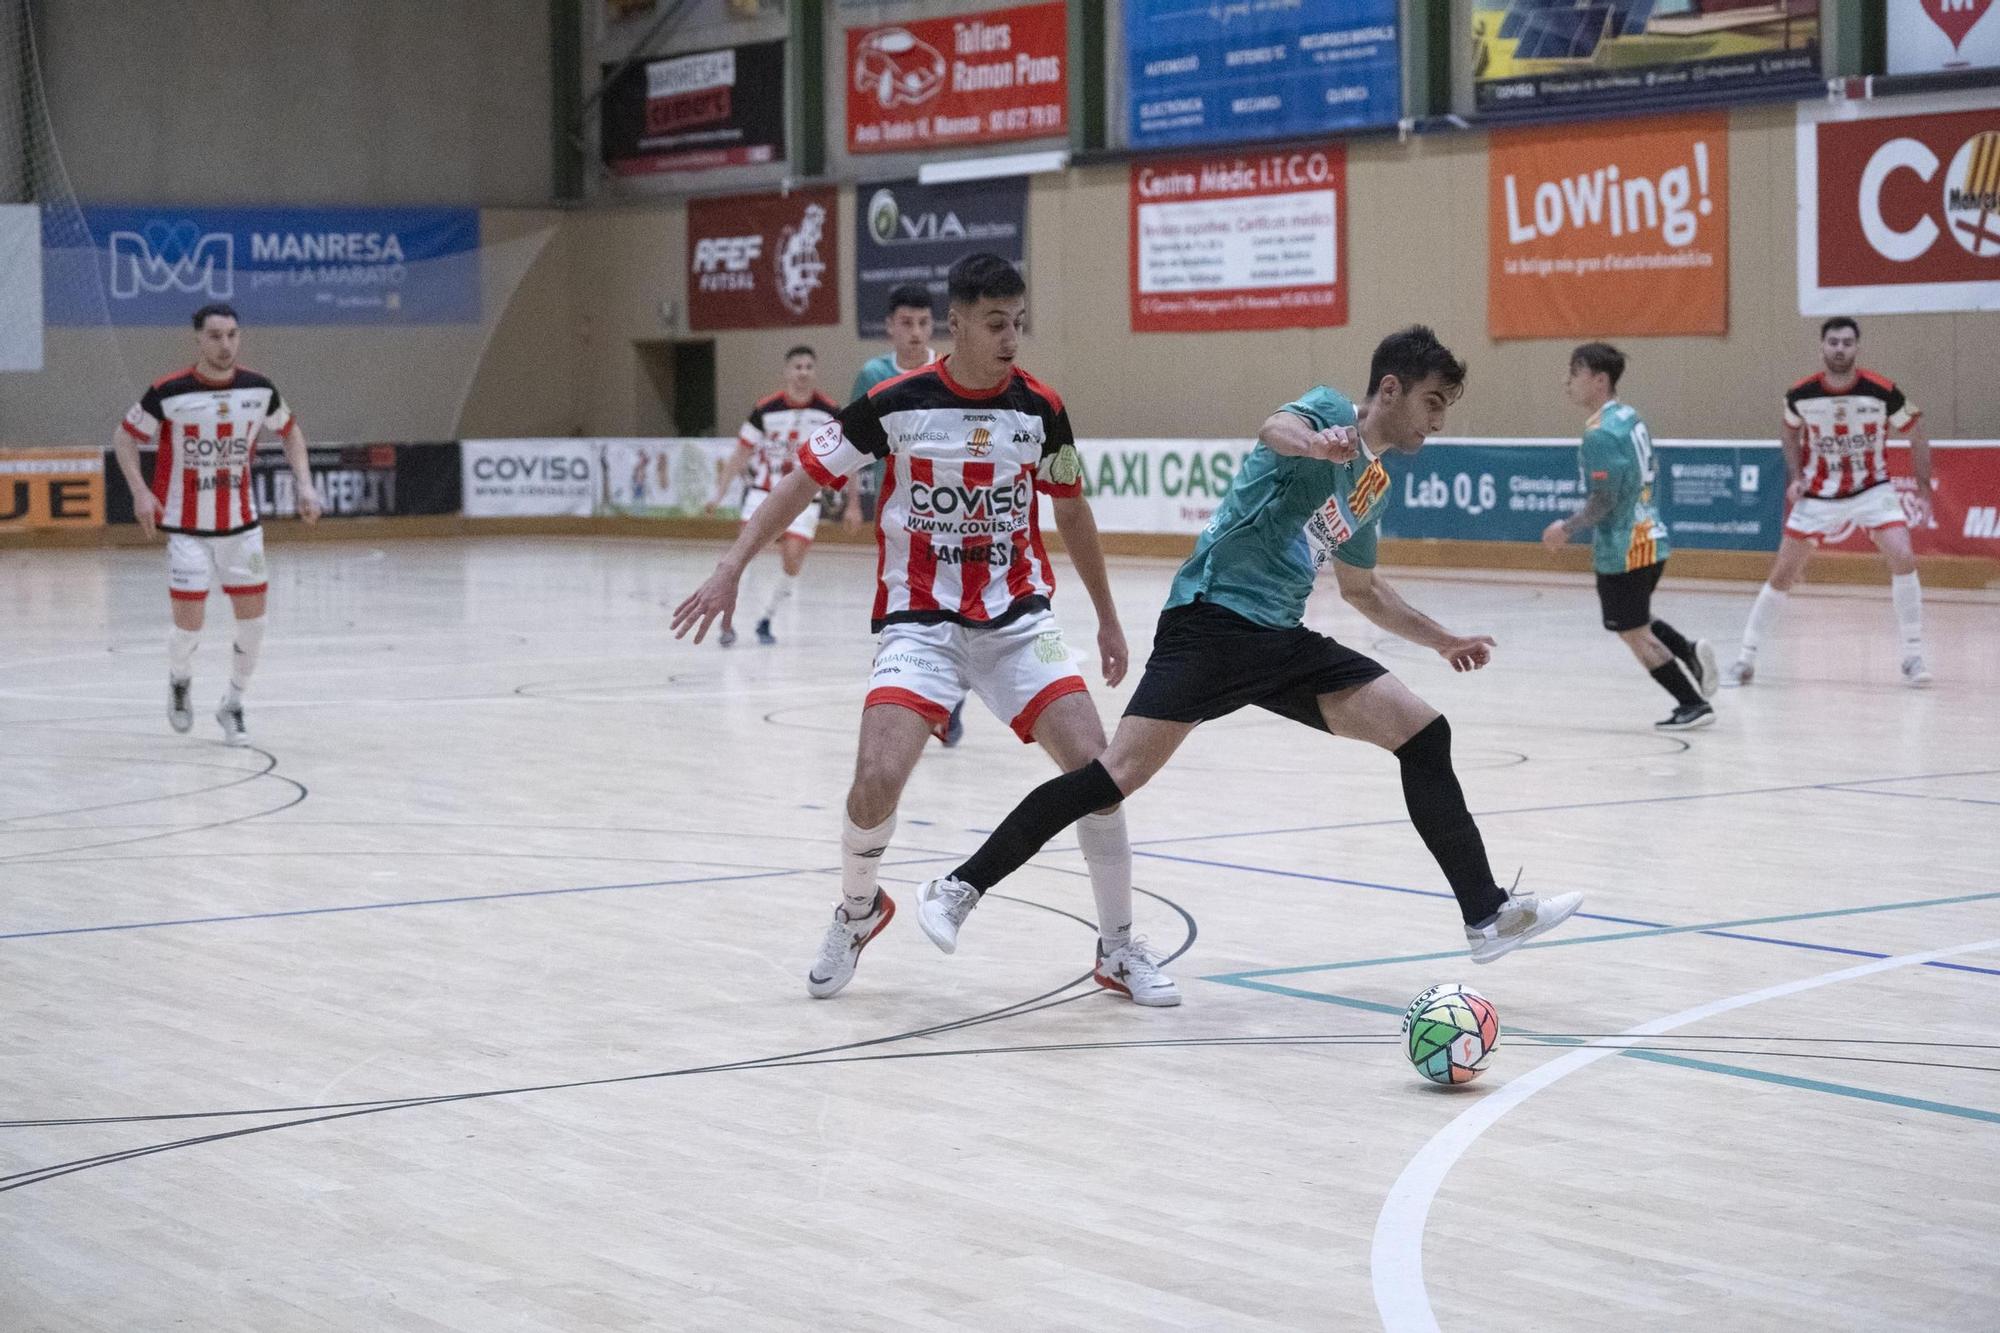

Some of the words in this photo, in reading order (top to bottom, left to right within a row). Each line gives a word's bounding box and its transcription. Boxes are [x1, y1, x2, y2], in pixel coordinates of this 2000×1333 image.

[953, 61, 1013, 91] Ramon
[1016, 54, 1060, 84] Pons
[1139, 168, 1195, 196] Centre
[901, 211, 967, 240] VIA
[252, 233, 403, 261] MANRESA
[183, 438, 247, 456] COVIS
[1405, 472, 1449, 508] Lab
[1453, 472, 1497, 515] 0_6
